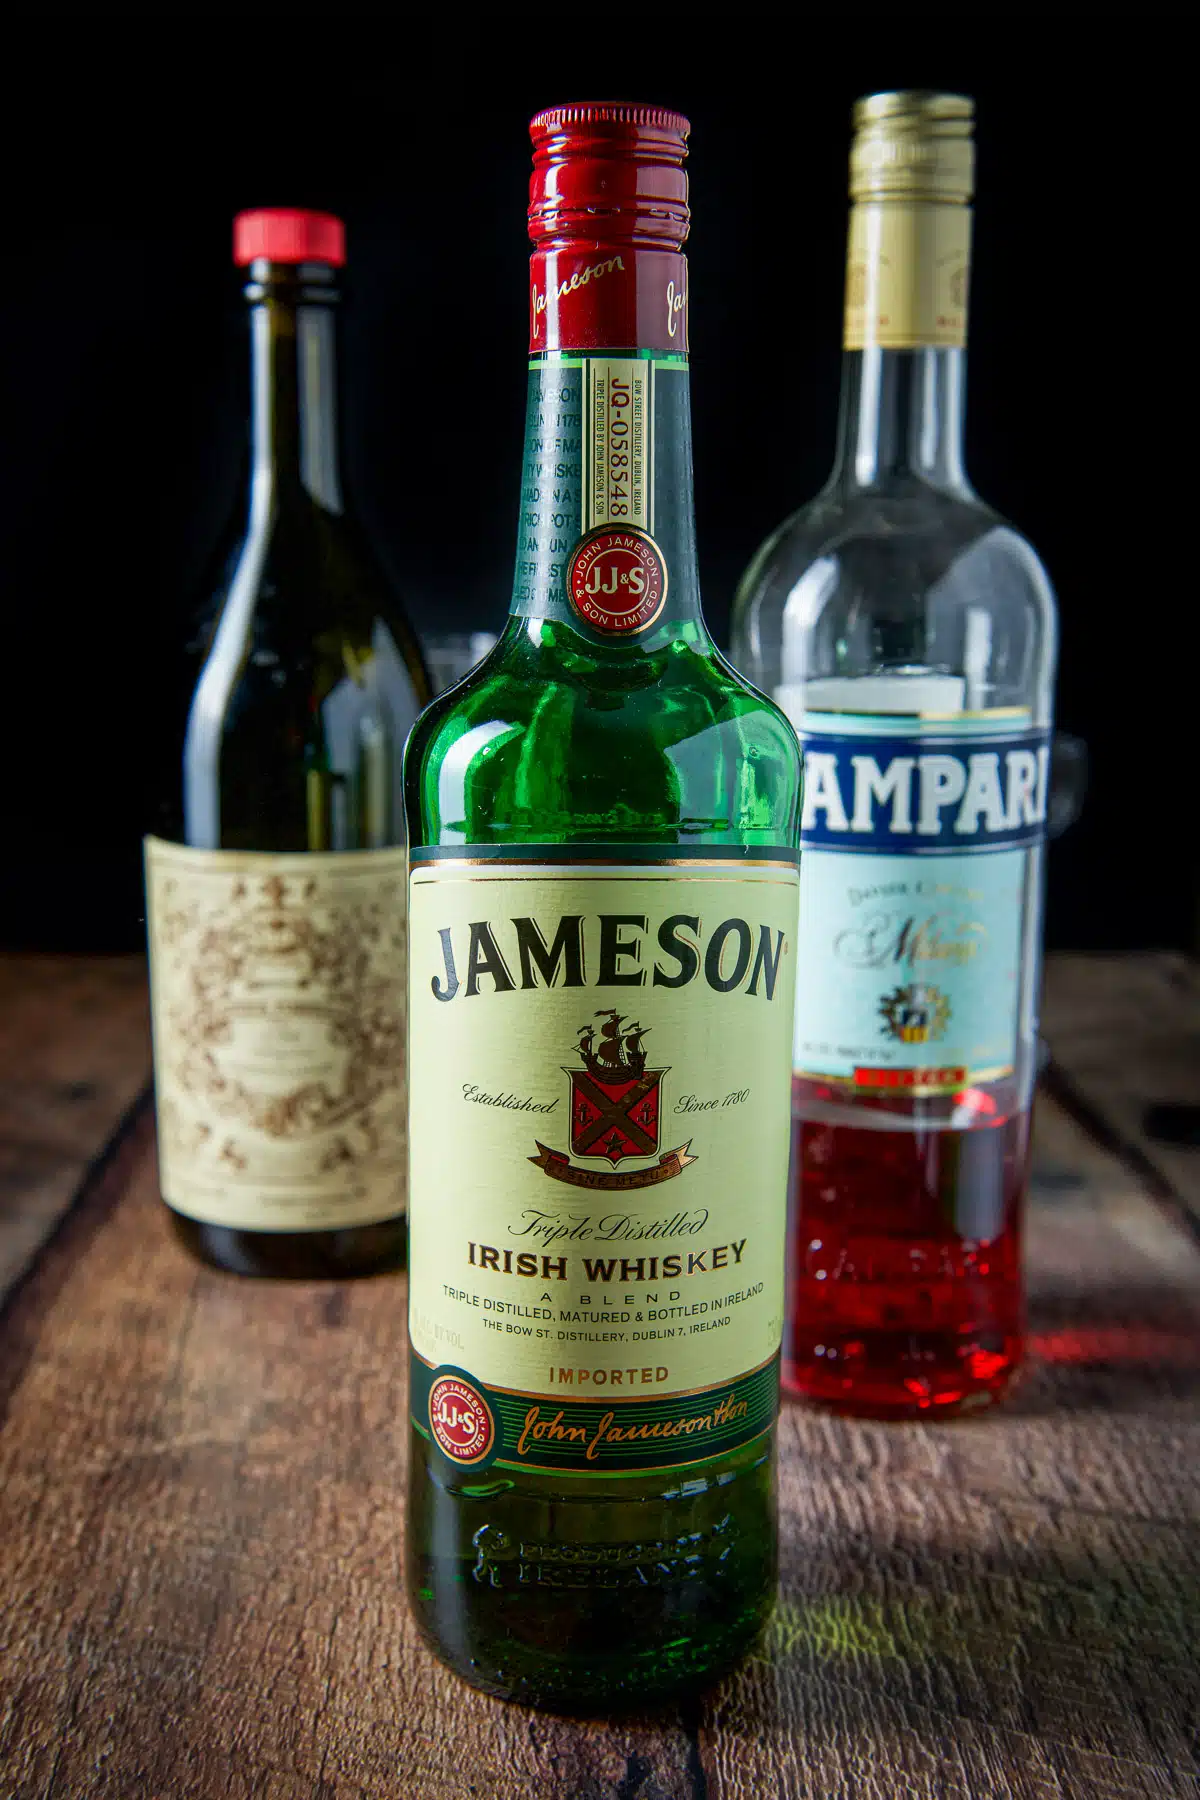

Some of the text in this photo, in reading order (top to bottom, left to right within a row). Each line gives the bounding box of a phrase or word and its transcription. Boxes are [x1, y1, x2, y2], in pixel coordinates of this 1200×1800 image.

[532, 255, 625, 340] Jameson
[667, 280, 686, 338] Ja
[596, 379, 605, 400] TRIPLE
[596, 401, 605, 432] DISTILLED
[596, 433, 605, 443] BY
[596, 444, 605, 461] JOHN
[610, 378, 630, 517] JQ-058548
[633, 380, 642, 516] BOW STREET DISTILLERY, DUBLIN, IRELAND
[596, 463, 605, 492] JAMESON
[596, 501, 605, 515] SON
[575, 536, 660, 578] JOHN JAMESON
[584, 566, 645, 595] JJ&S
[582, 602, 609, 625] SON
[614, 589, 659, 627] LIMITED
[461, 1083, 560, 1114] Established
[673, 1088, 751, 1115] Since 1780
[507, 1208, 709, 1248] Triple Distilled
[467, 1237, 748, 1282] IRISH WHISKEY
[443, 1281, 765, 1324] TRIPLE DISTILLED, MATURED & BOTTLED IN IRELAND
[540, 1291, 681, 1305] A BLEND
[483, 1318, 503, 1332] THE
[506, 1324, 533, 1337] BOW
[536, 1328, 554, 1340] ST.
[557, 1331, 629, 1343] DISTILLERY,
[632, 1328, 675, 1342] DUBLIN
[689, 1316, 732, 1335] IRELAND
[550, 1366, 669, 1386] IMPORTED
[436, 1400, 475, 1435] JJ&S
[450, 1383, 486, 1425] JAMESON
[453, 1433, 485, 1456] LIMITED
[517, 1406, 587, 1456] John
[586, 1411, 711, 1461] Jameson
